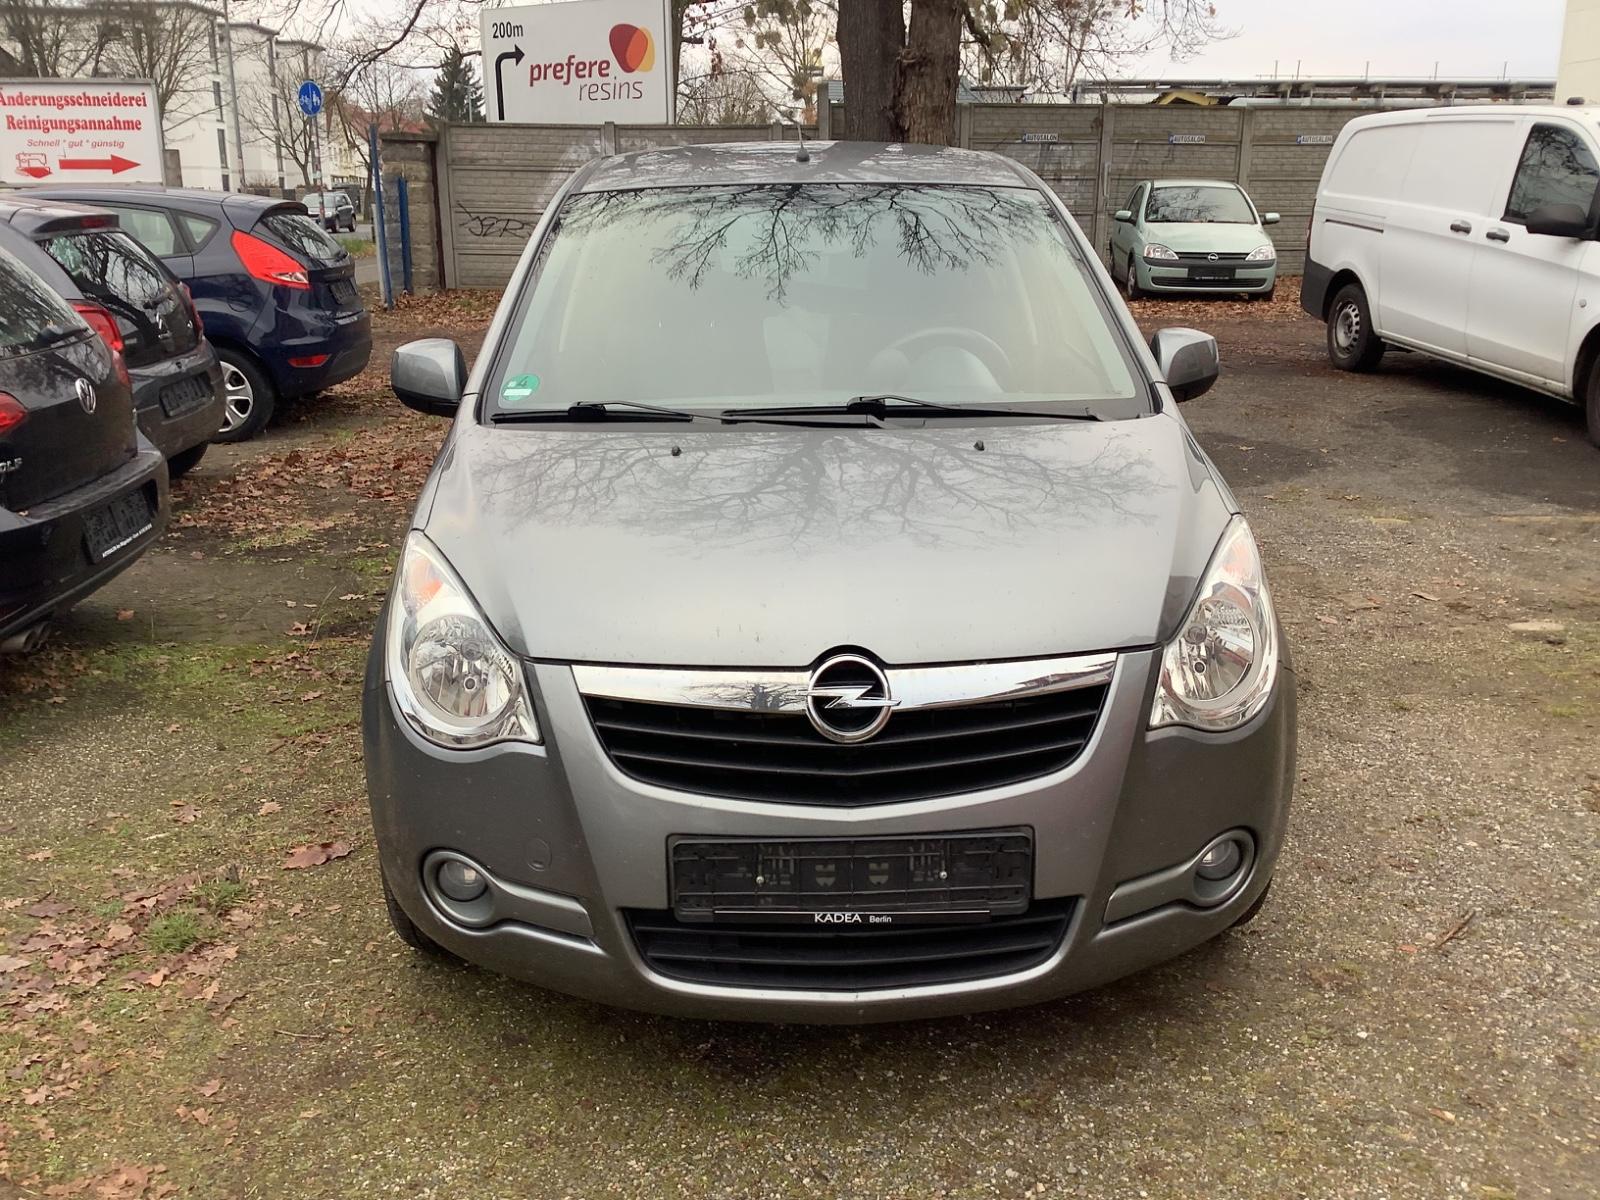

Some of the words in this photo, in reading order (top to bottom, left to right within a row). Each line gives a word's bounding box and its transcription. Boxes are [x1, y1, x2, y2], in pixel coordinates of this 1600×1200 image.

[492, 21, 524, 39] 200m
[529, 55, 611, 87] prefere
[579, 76, 643, 101] resins
[6, 114, 142, 134] Reinigungsannahme
[26, 139, 60, 147] Schnell
[68, 139, 83, 148] gut
[91, 139, 125, 149] günstig
[814, 913, 862, 923] KADEA
[869, 915, 892, 923] Berlin
